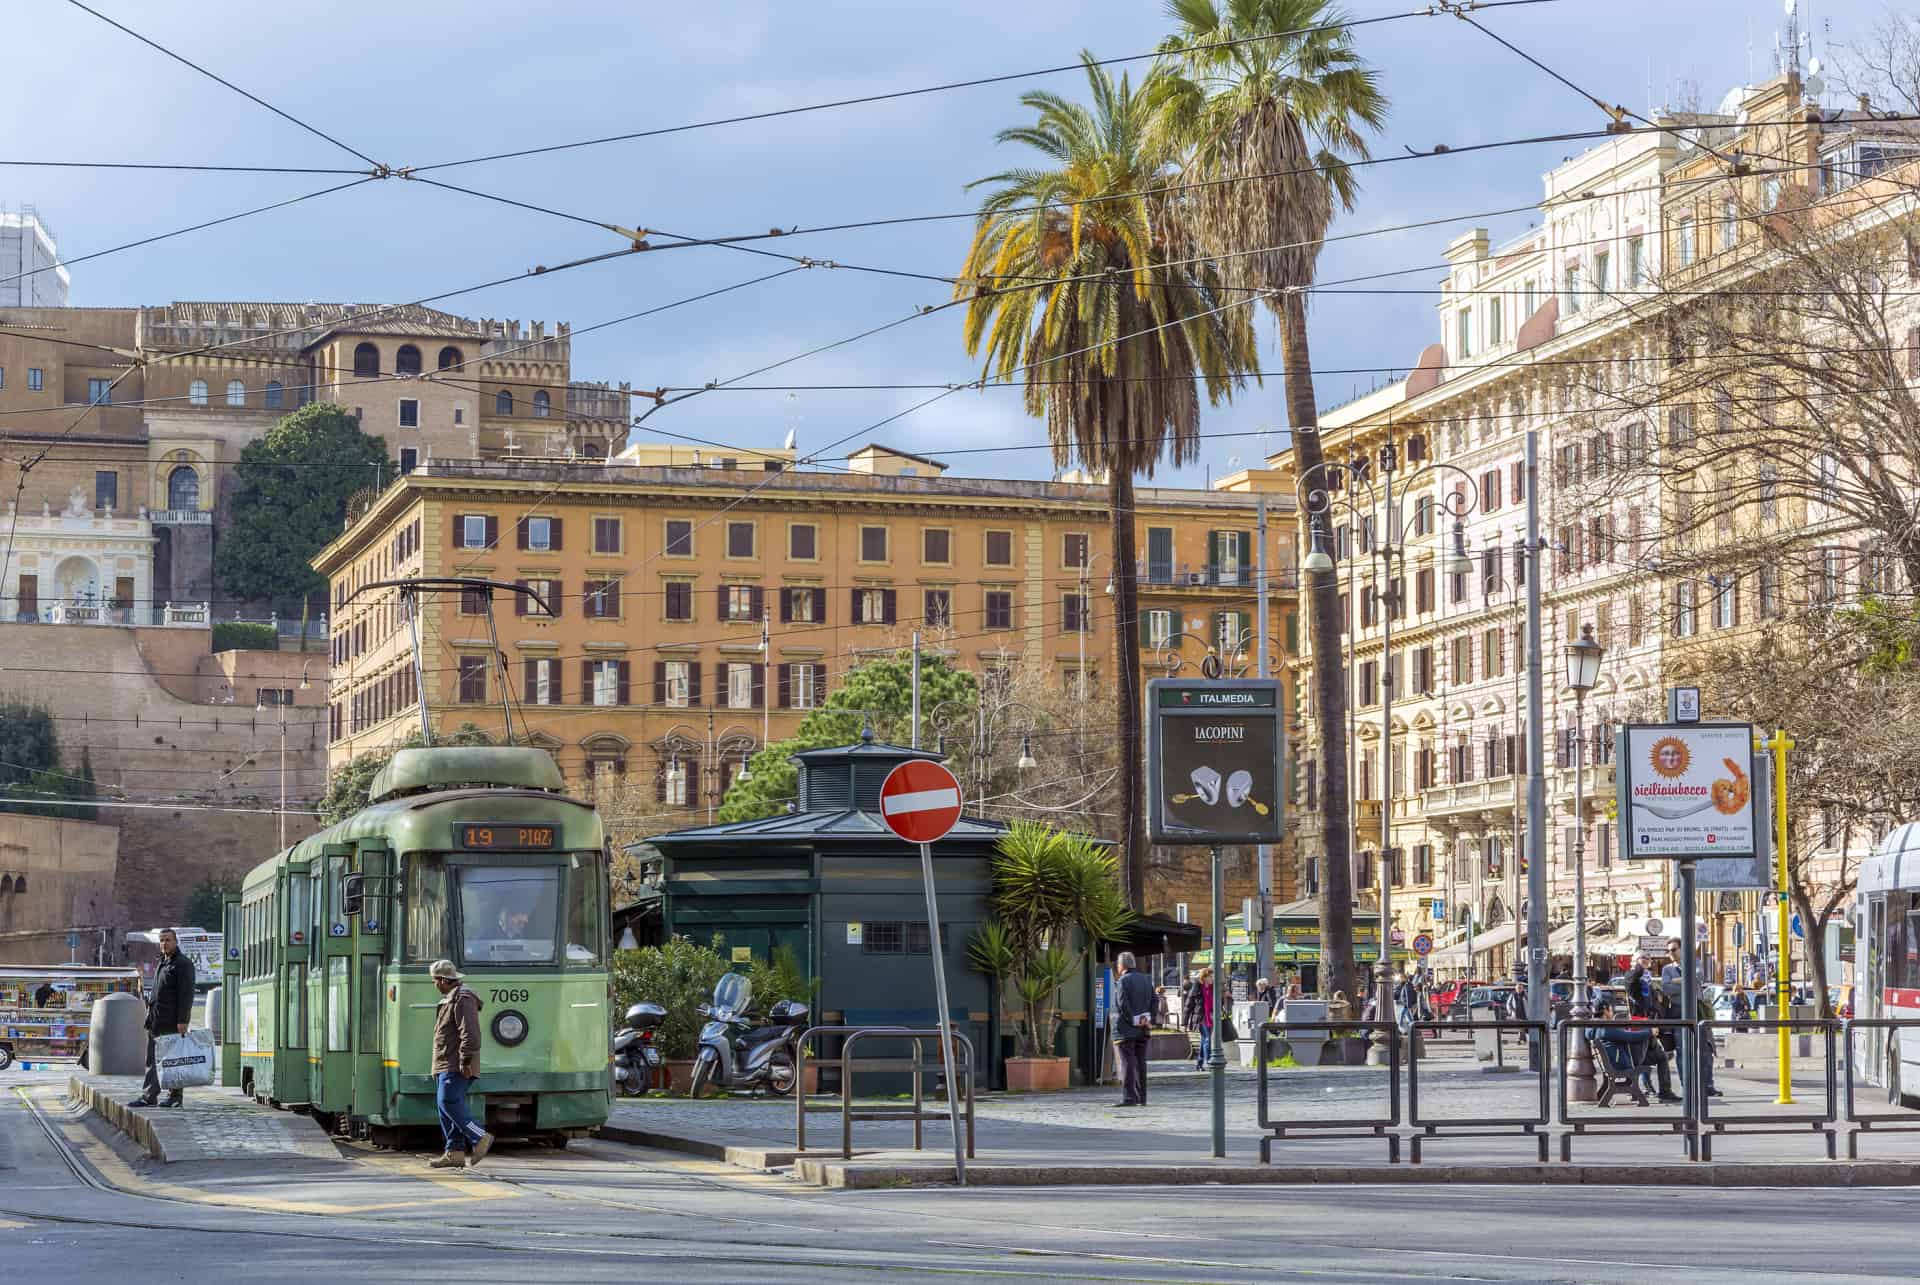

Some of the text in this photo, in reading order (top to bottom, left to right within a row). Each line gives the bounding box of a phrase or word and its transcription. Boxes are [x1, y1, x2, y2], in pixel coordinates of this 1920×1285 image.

[1200, 694, 1254, 703] ITALMEDIA
[1195, 727, 1244, 739] IACOPINI
[467, 829, 552, 847] 19 PIAZ
[490, 989, 529, 1003] 7069
